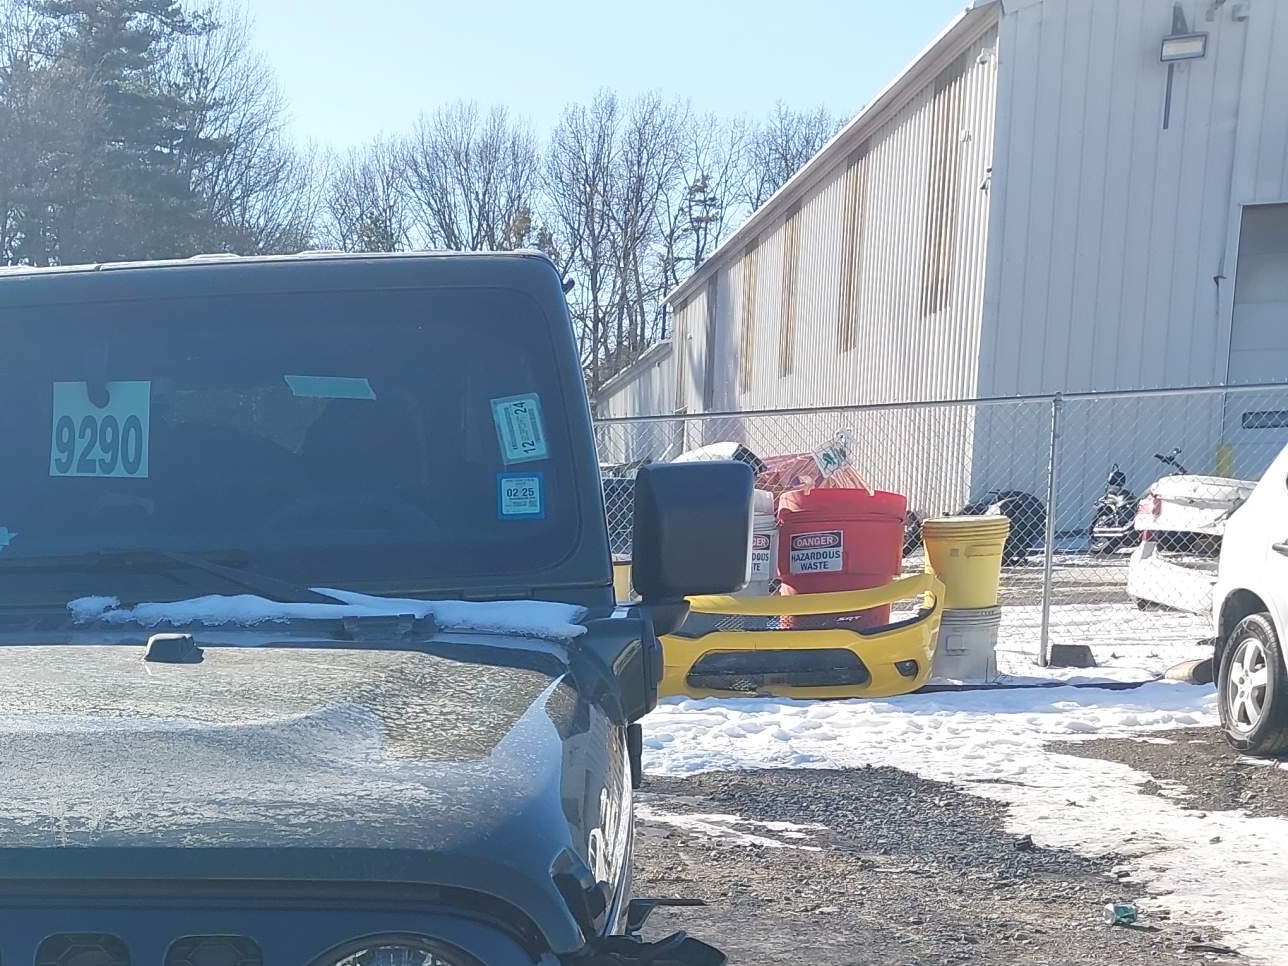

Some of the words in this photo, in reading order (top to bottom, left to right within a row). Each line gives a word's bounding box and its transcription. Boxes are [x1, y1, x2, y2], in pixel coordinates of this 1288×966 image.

[512, 401, 528, 415] 24
[55, 414, 143, 475] 9290
[506, 488, 519, 497] 02
[521, 487, 535, 497] 25
[796, 536, 834, 547] DANGER
[792, 550, 841, 562] HAZARDOUS
[800, 560, 829, 571] WASTE
